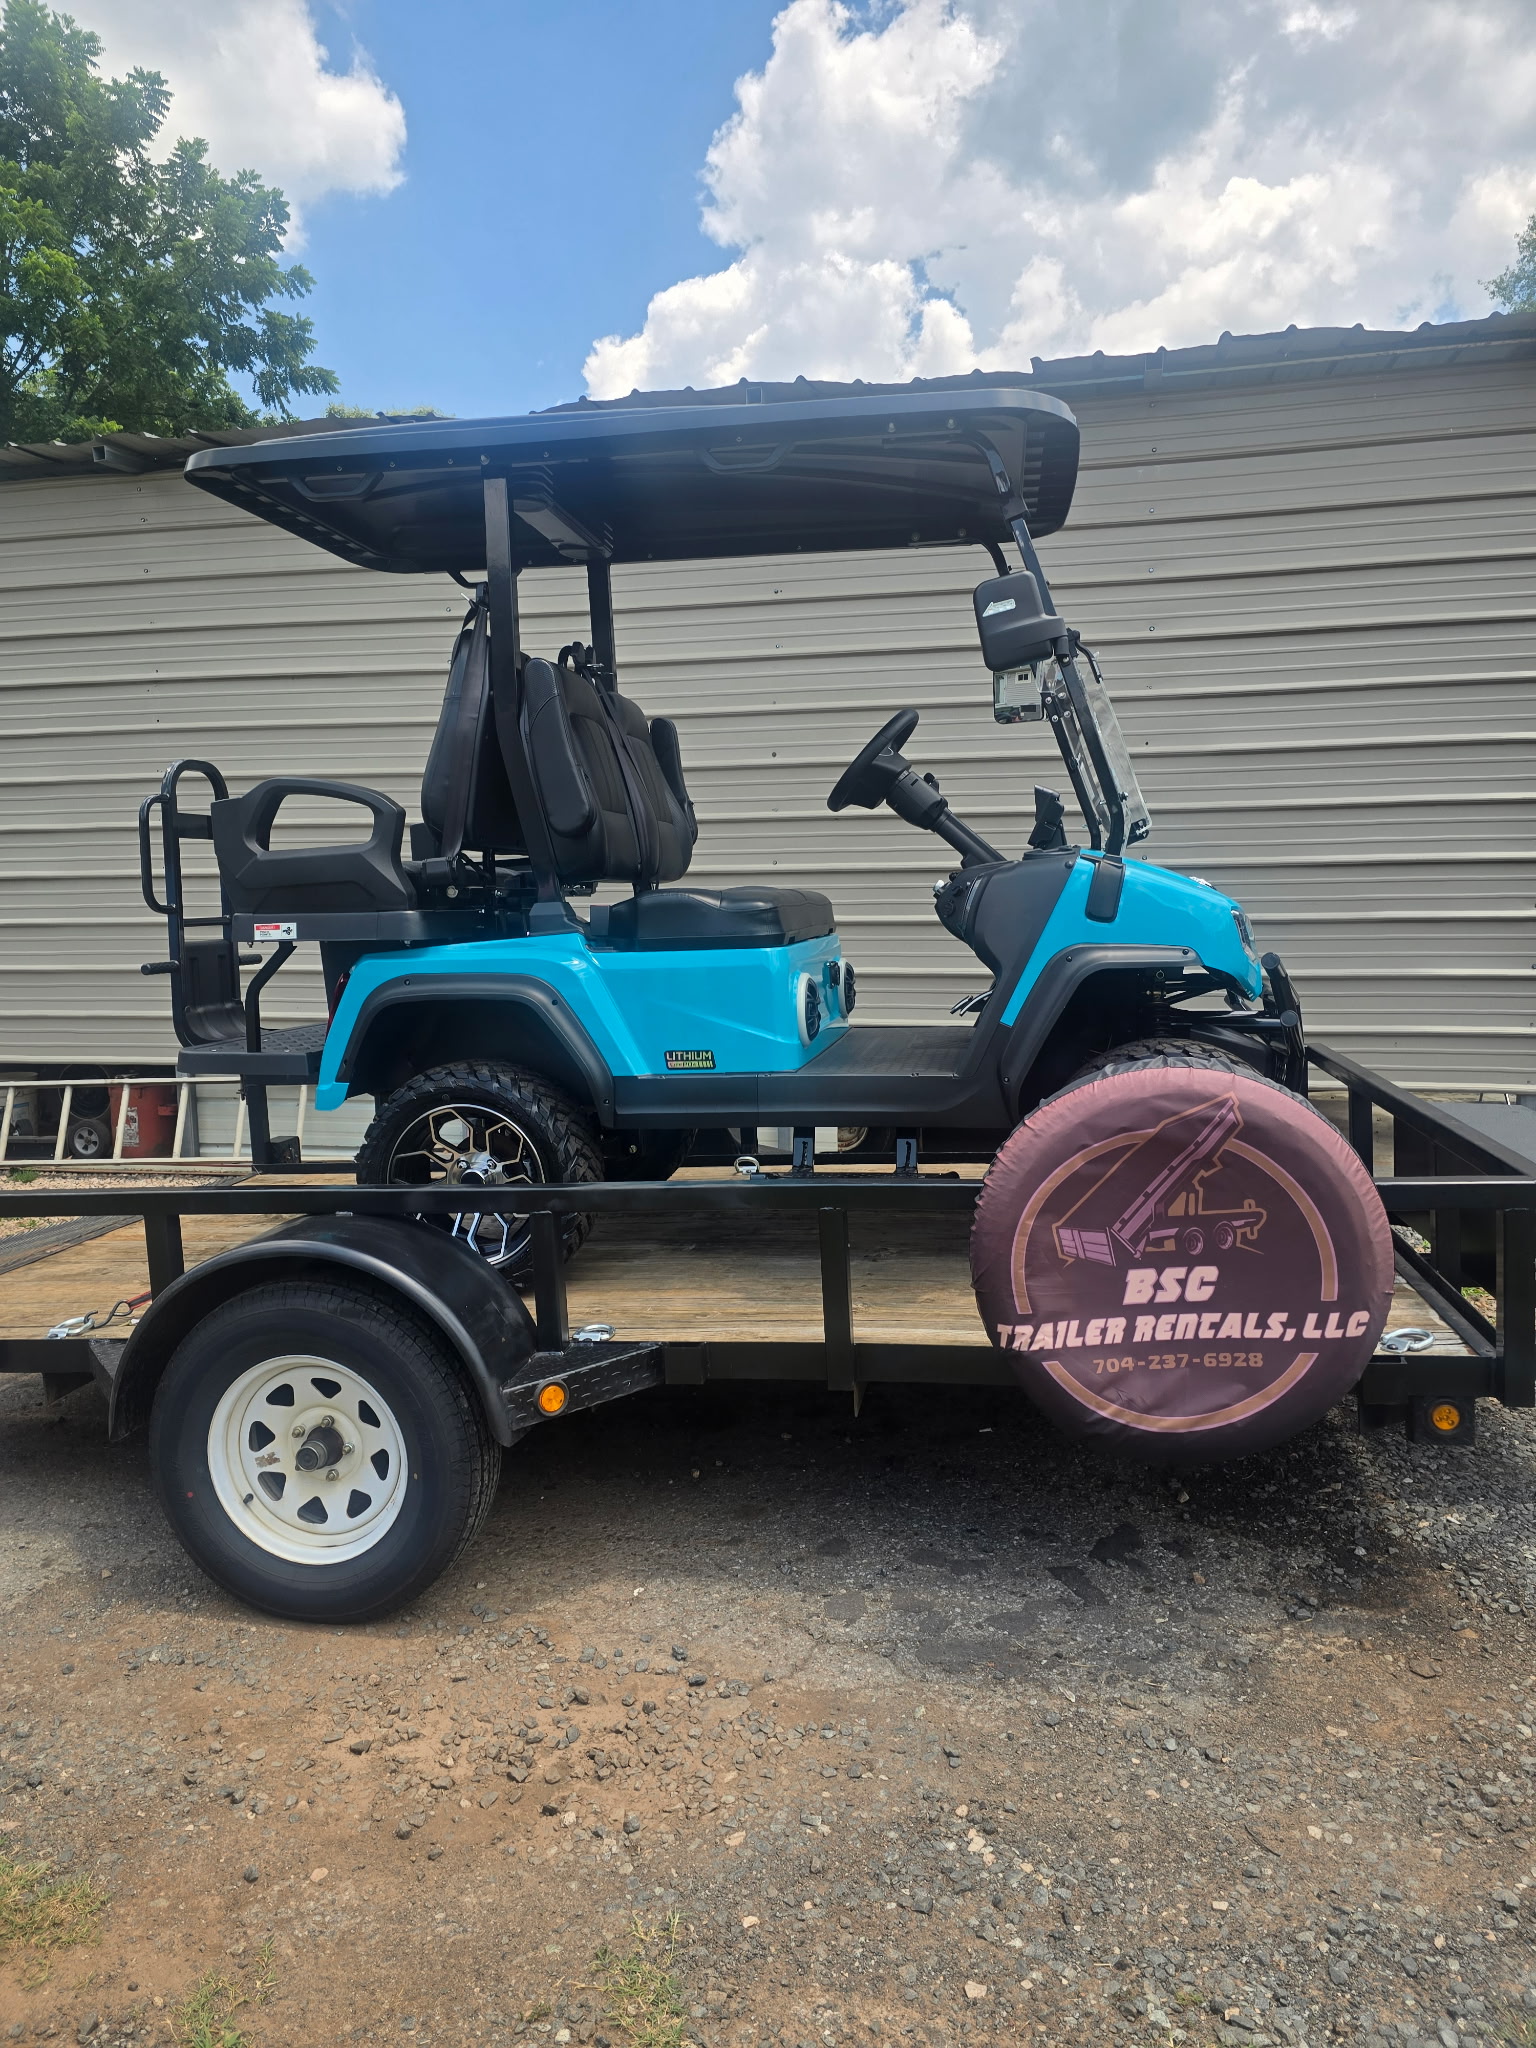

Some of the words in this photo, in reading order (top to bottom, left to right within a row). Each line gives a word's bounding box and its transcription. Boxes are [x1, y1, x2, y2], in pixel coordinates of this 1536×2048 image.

[666, 1051, 712, 1061] LITHIUM
[1122, 1266, 1219, 1306] BSC
[997, 1316, 1127, 1352] TRAILER
[1132, 1312, 1296, 1342] RENTALS,
[1302, 1310, 1371, 1339] LLC
[1093, 1352, 1264, 1374] 704-237-6928
